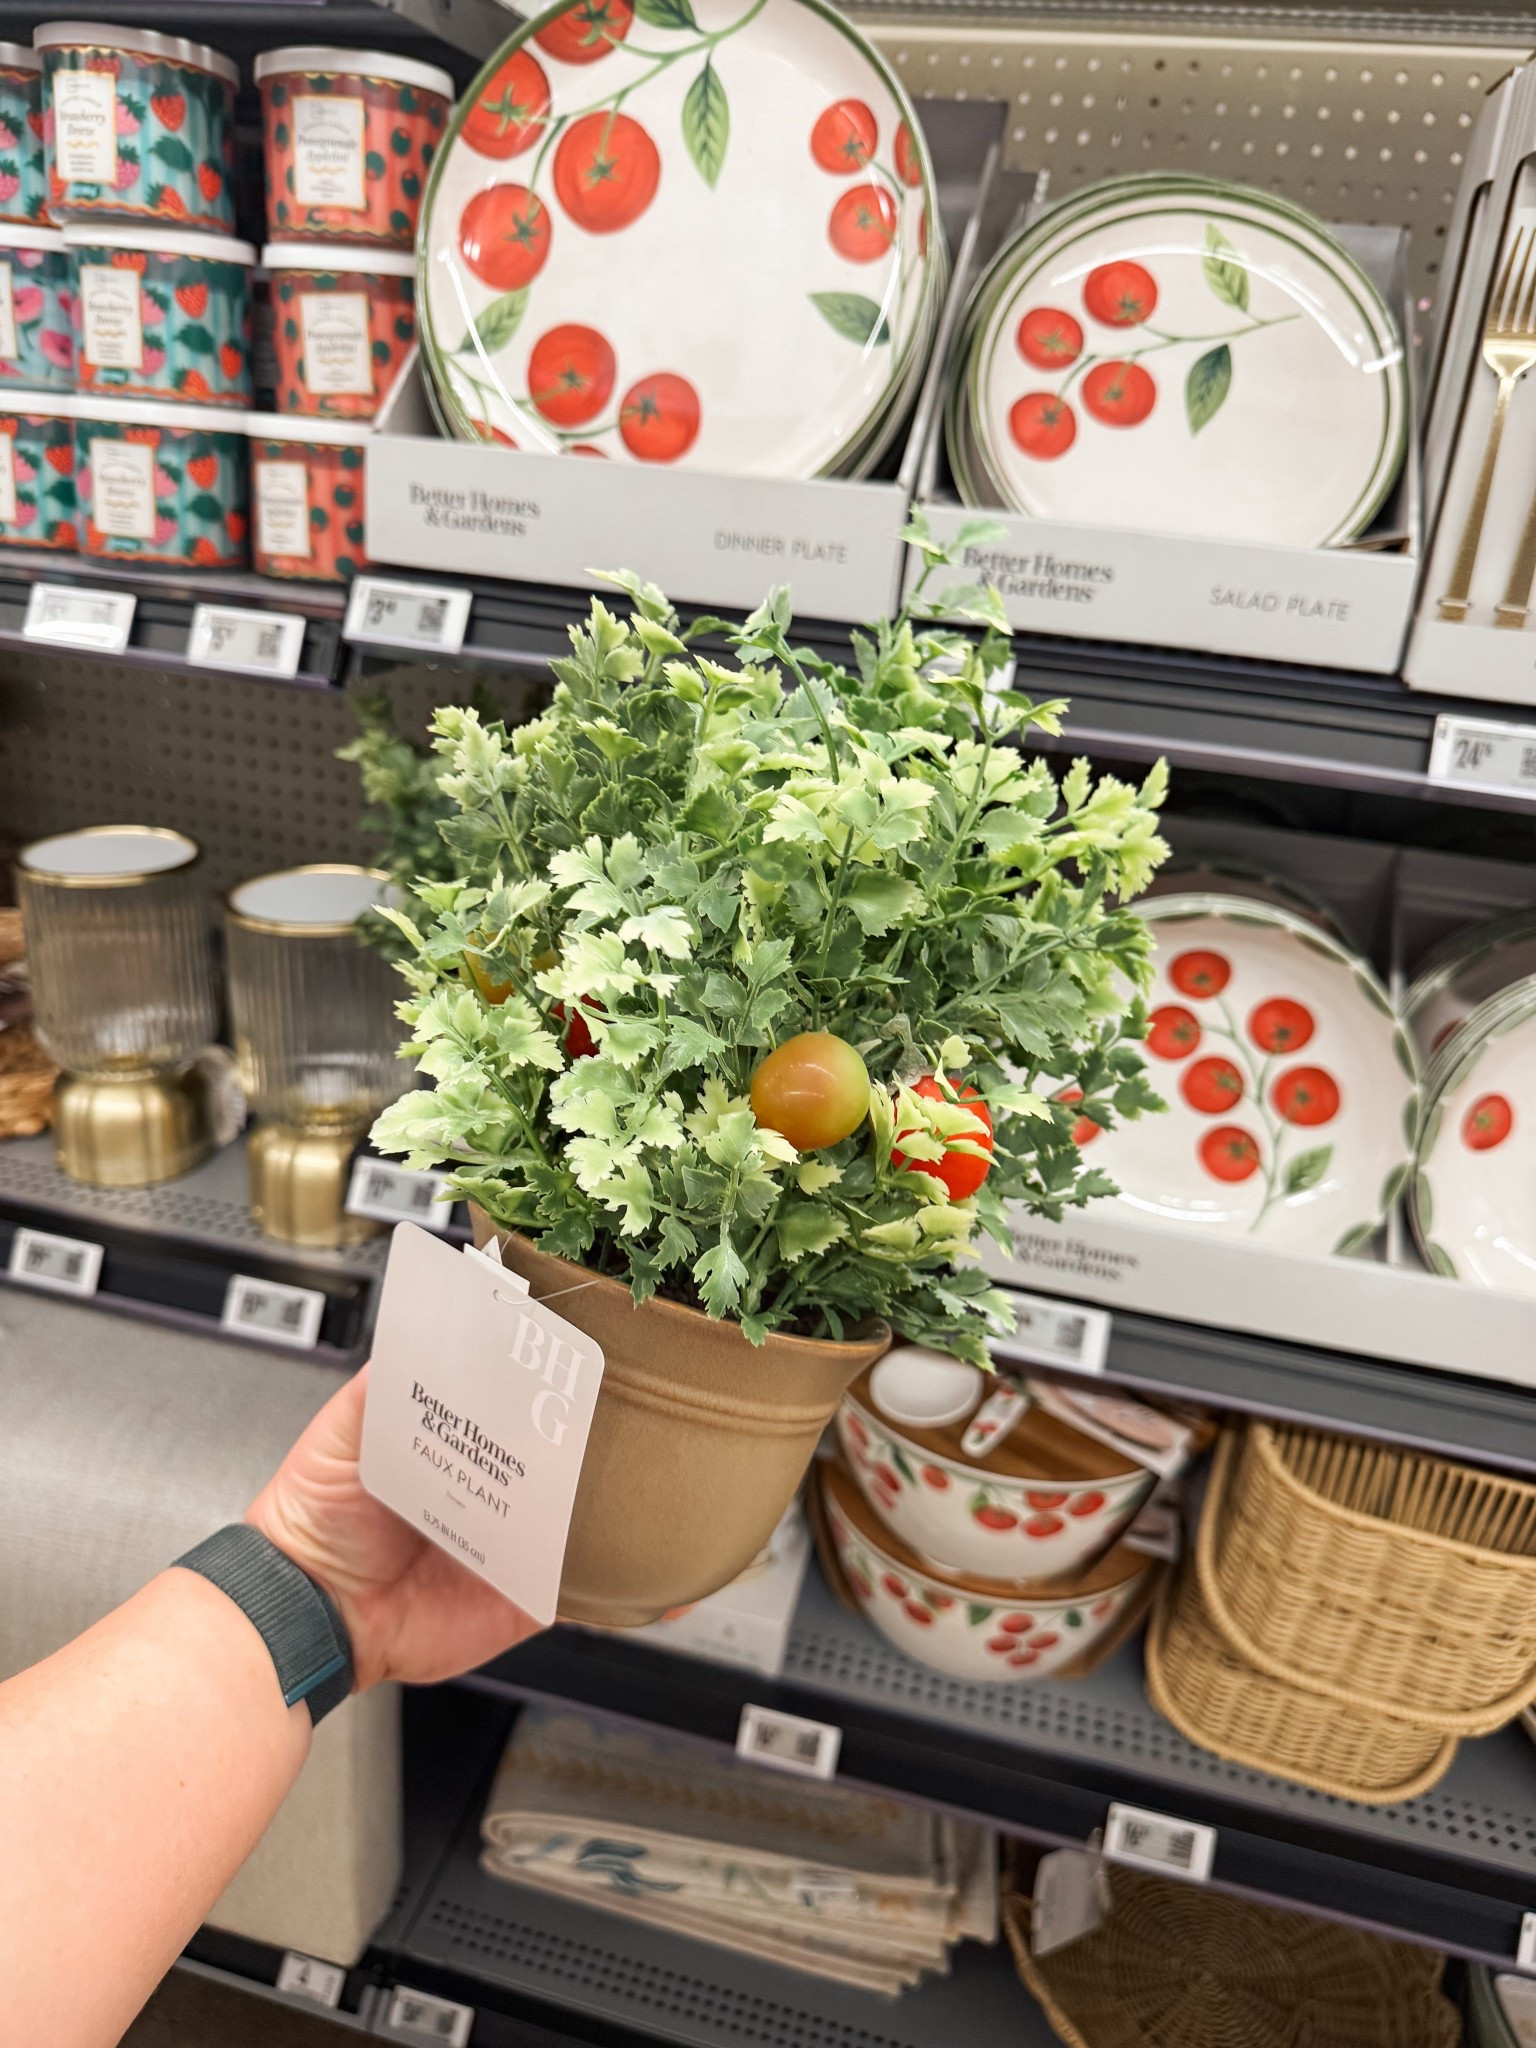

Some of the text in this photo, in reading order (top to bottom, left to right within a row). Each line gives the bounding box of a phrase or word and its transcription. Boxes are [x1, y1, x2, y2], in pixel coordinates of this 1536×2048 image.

[409, 483, 541, 519] Better Homes
[714, 530, 848, 565] DINNER PLATE
[963, 547, 1114, 584] Better Homes
[1208, 584, 1351, 622] SALAD PLATE
[1009, 1228, 1138, 1268] etter Homes
[411, 1380, 526, 1477] Better Homes
[413, 1436, 511, 1518] FAUX PLANT
[470, 1547, 486, 1565] cm)
